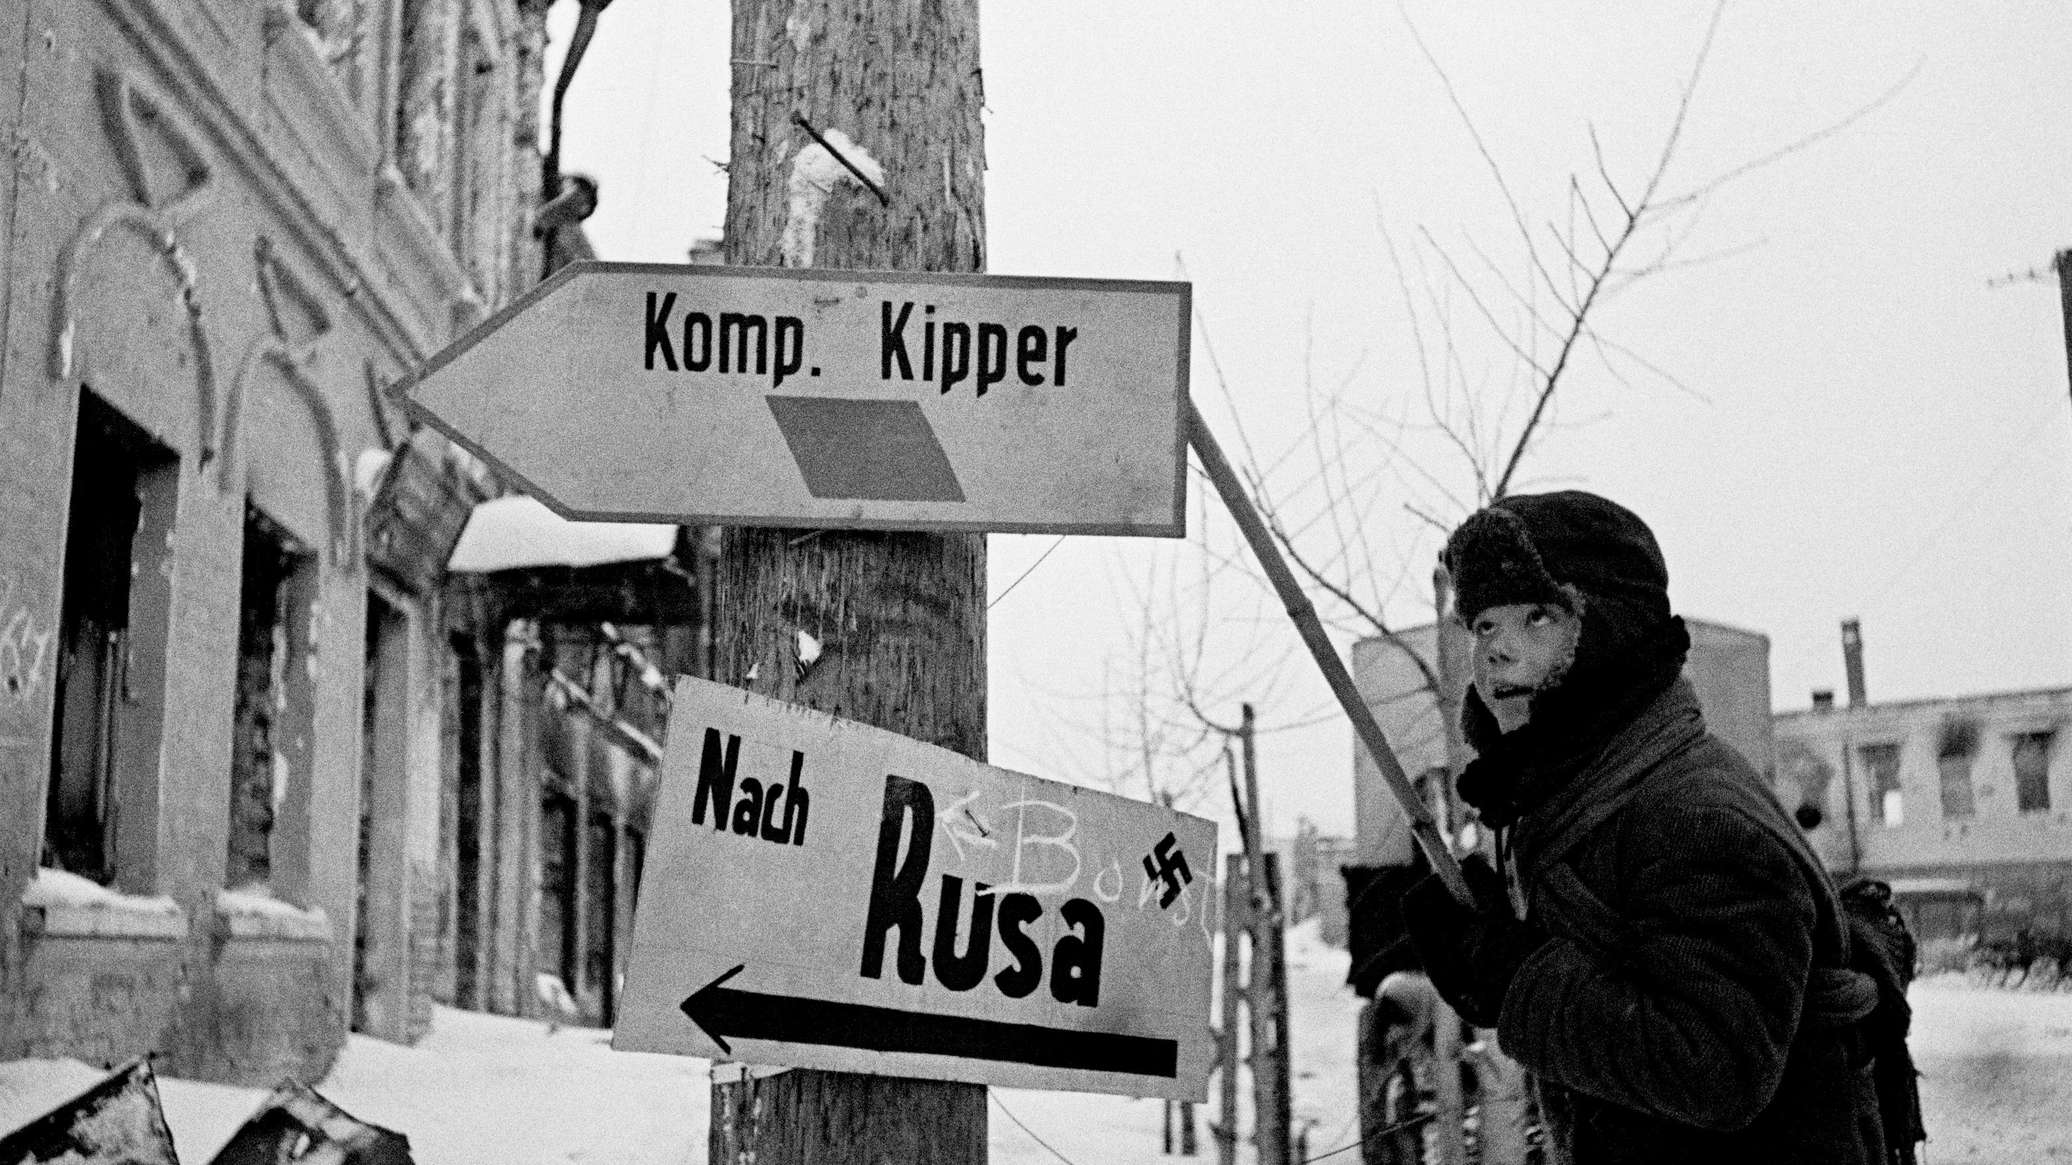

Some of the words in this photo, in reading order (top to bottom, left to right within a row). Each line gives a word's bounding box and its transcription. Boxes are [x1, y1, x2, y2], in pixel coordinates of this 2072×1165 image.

[644, 292, 821, 390] Komp.
[881, 301, 1078, 398] Kipper
[692, 727, 810, 846] Nach
[860, 774, 1105, 1008] Rusa
